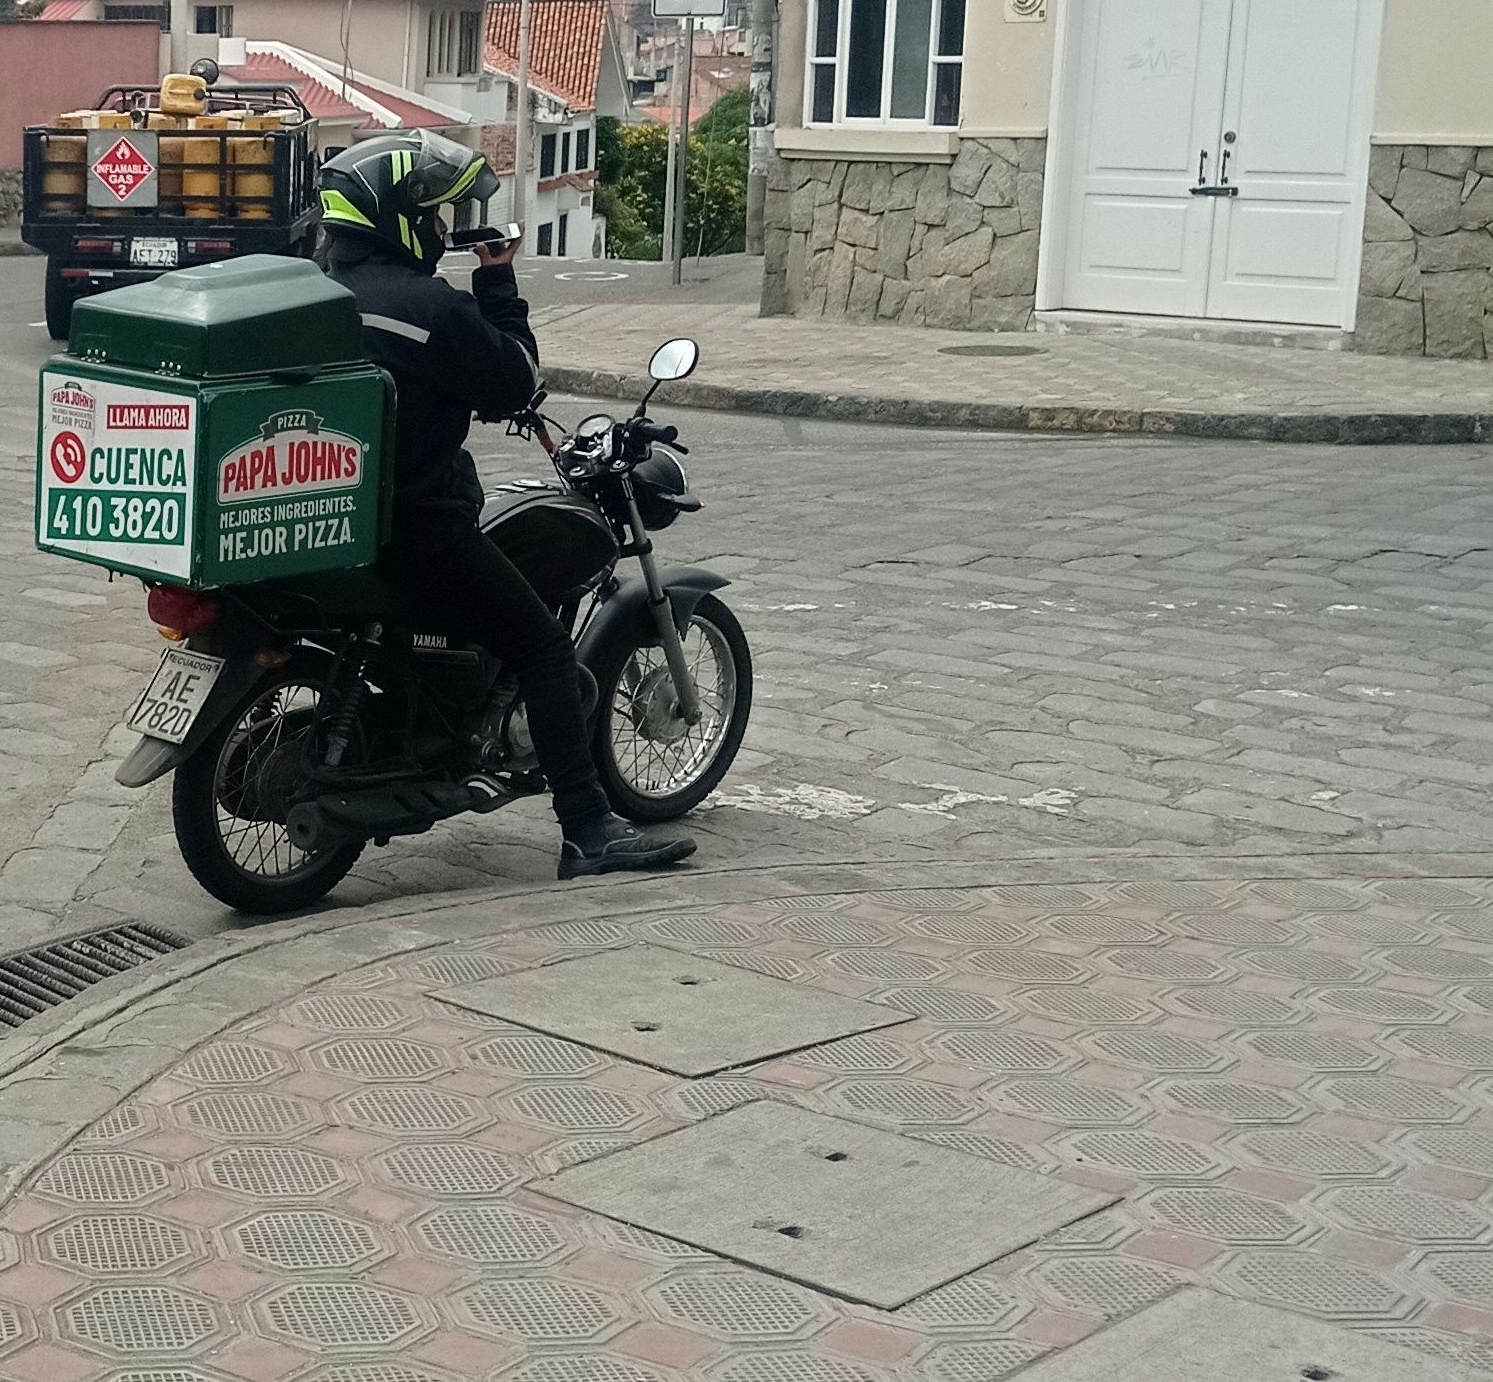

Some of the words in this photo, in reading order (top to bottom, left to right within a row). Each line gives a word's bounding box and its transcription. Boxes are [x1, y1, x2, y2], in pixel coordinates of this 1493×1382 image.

[96, 164, 149, 174] INFLAMABLE
[108, 174, 134, 185] GAS
[117, 184, 127, 196] 2
[53, 390, 70, 404] PAPA
[52, 414, 73, 427] MEJOR
[109, 407, 145, 427] LLAMA
[148, 408, 187, 427] AHORA
[277, 414, 307, 430] PIZZA
[89, 446, 187, 487] CUENCA
[223, 445, 278, 494] PAPA
[281, 440, 357, 486] JOHN'S
[53, 495, 103, 537] 410
[108, 496, 179, 541] 3820
[220, 506, 272, 529] MEJORES
[274, 496, 357, 521] INGREDIENTES.
[219, 526, 287, 563] MEJOR
[294, 517, 355, 551] PIZZA.
[413, 633, 447, 648] YAMAHA
[171, 655, 212, 673] ECUADOR
[161, 670, 201, 704] AE
[134, 698, 192, 736] 782D
